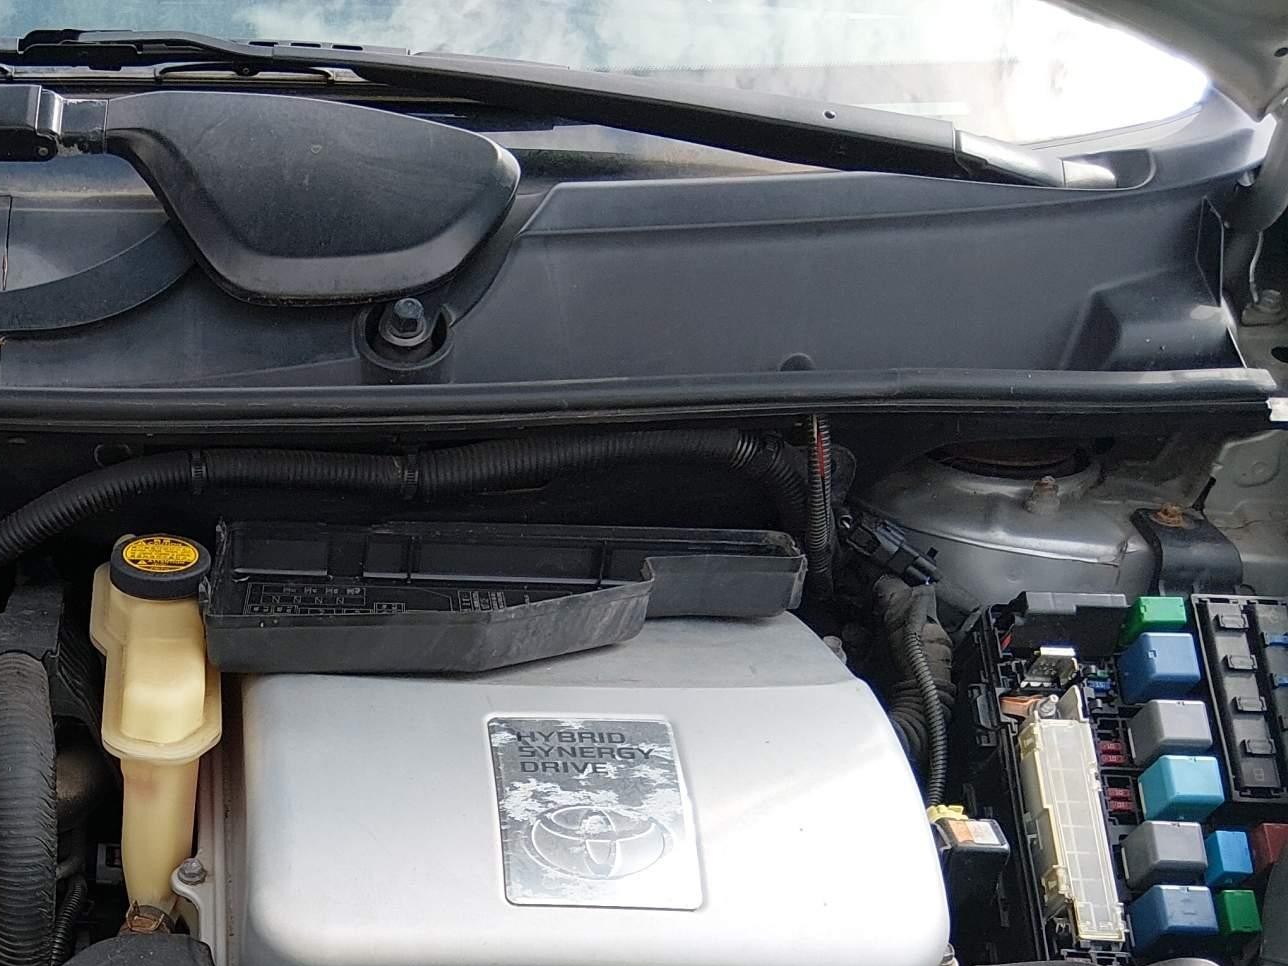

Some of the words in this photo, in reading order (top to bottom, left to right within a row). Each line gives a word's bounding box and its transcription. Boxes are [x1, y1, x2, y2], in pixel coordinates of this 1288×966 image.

[516, 731, 626, 744] HYBRID
[518, 746, 654, 760] SYNERGY
[520, 761, 609, 774] DRIVE
